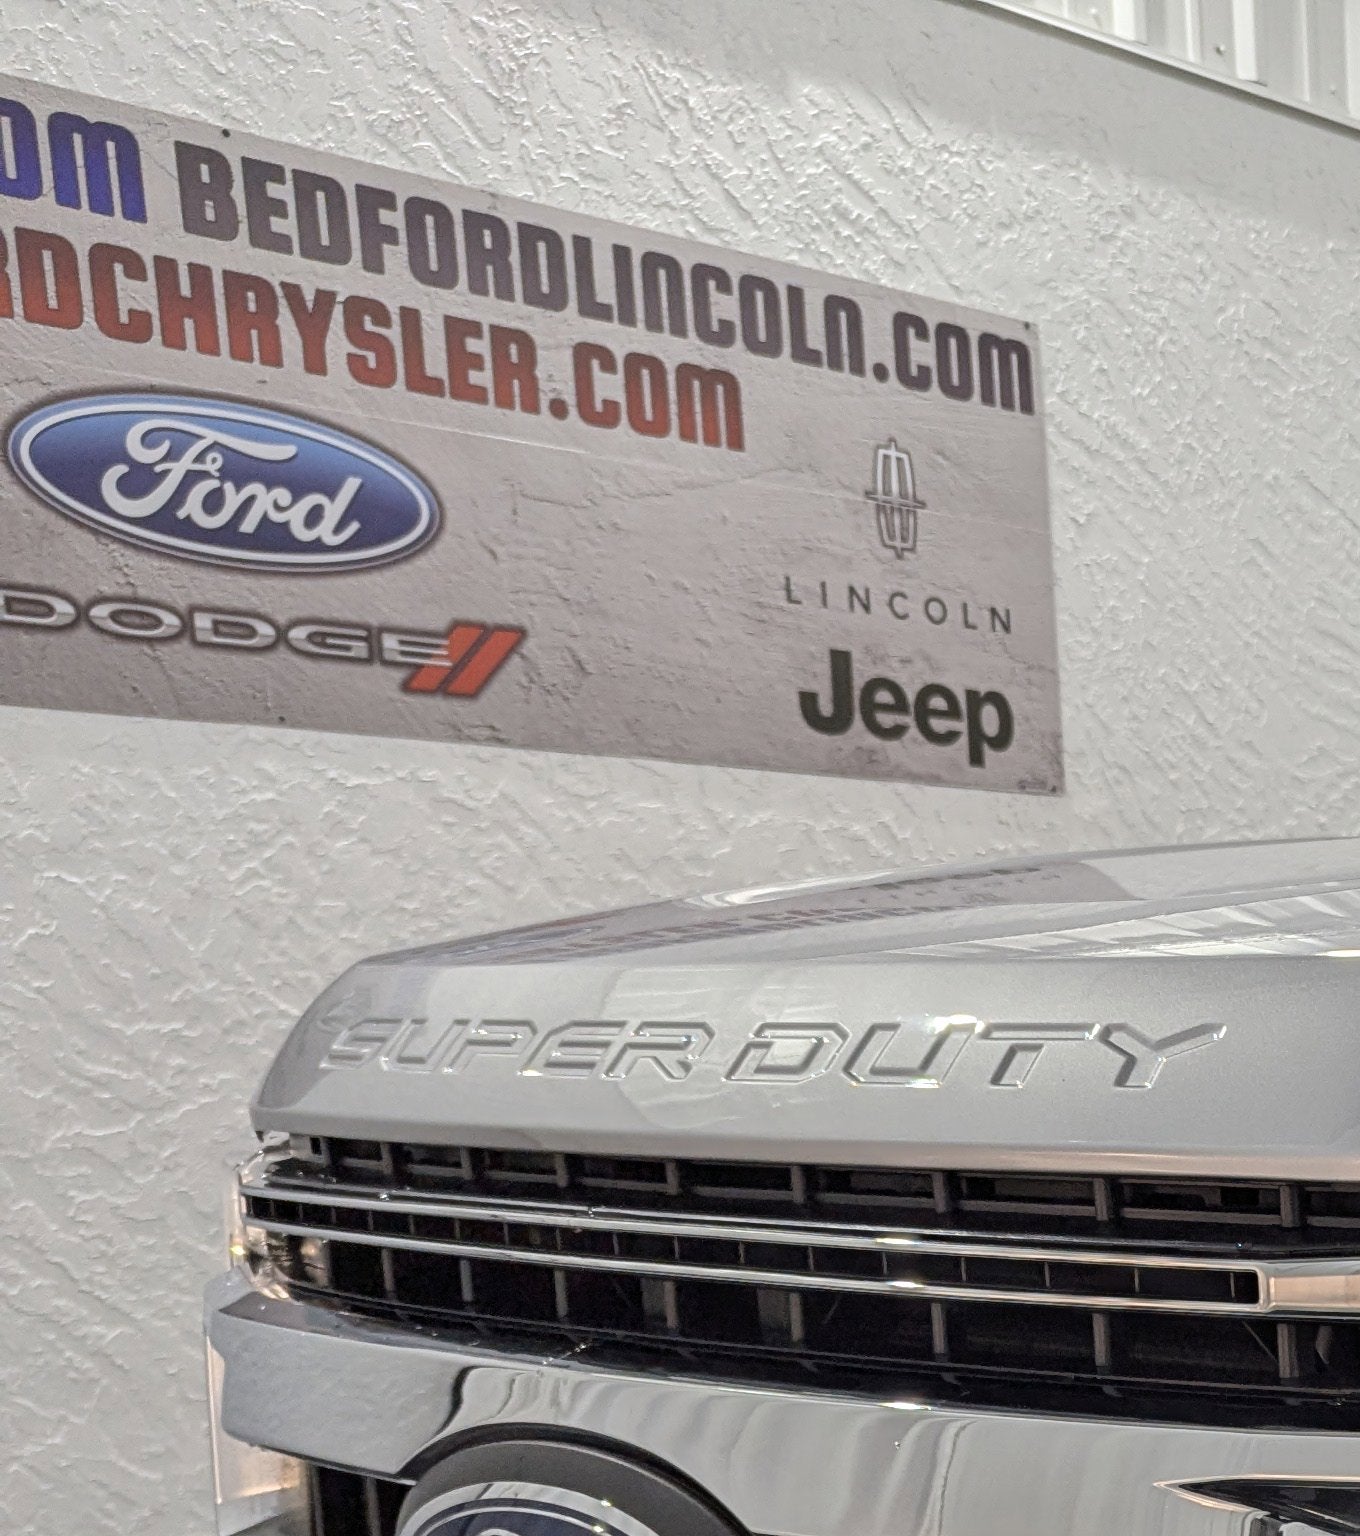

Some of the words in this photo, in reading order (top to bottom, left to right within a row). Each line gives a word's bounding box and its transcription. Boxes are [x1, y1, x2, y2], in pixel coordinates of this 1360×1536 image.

[0, 226, 745, 452] DCHRYSLER.COM
[101, 418, 362, 546] Ford
[0, 588, 453, 668] DODGE
[784, 575, 1012, 635] LINCOLN
[798, 648, 1015, 769] Jeep
[319, 1018, 716, 1082] SUPER
[722, 1016, 1228, 1089] DUTY
